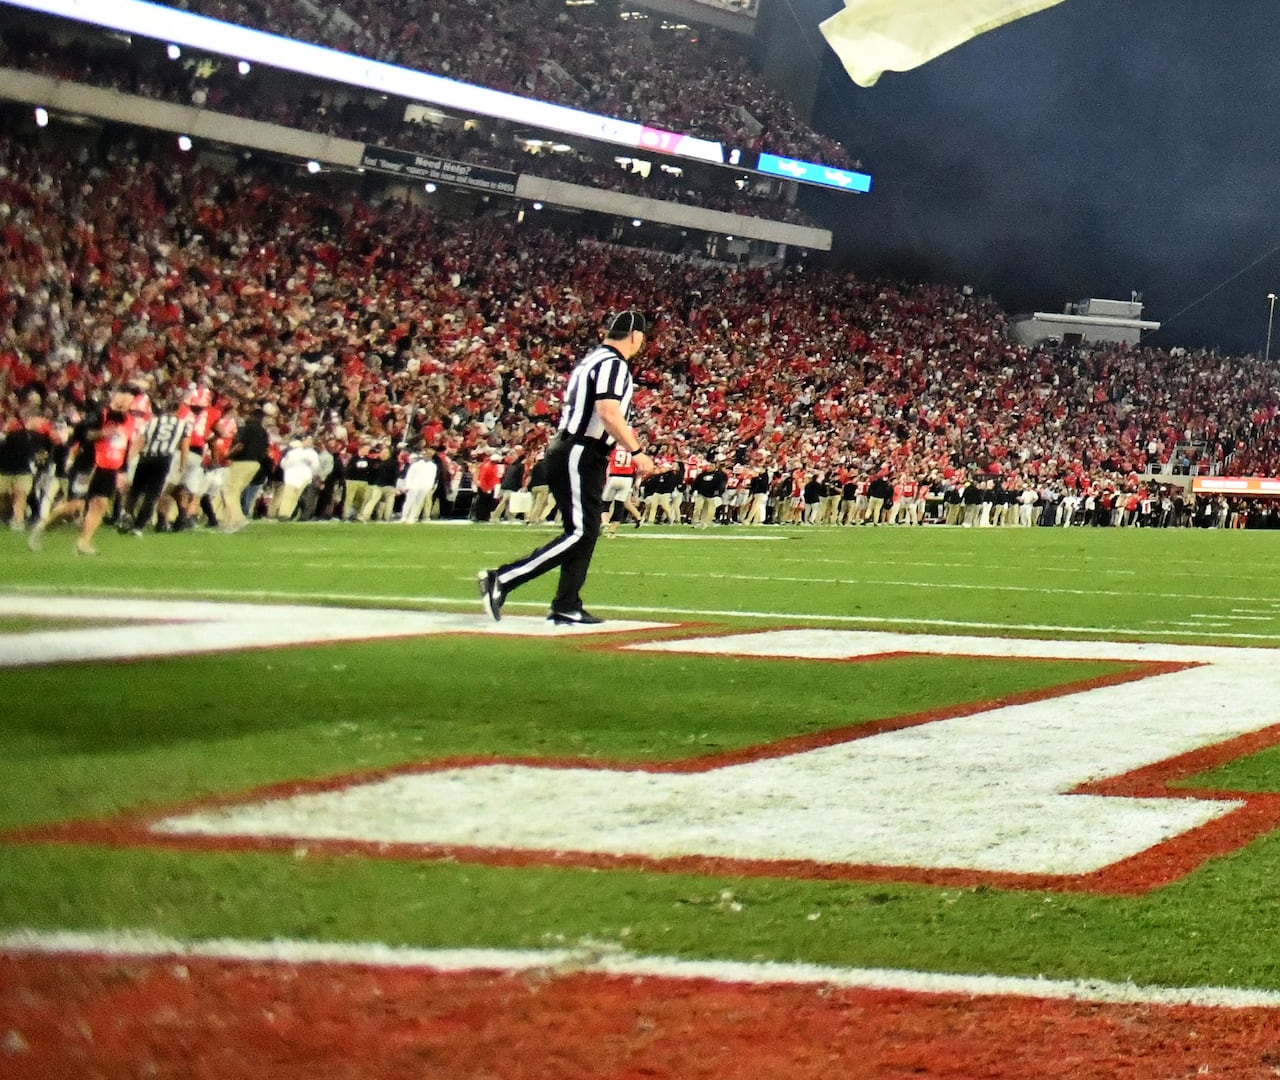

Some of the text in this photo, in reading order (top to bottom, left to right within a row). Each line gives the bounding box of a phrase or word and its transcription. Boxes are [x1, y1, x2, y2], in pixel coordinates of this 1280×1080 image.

[415, 156, 471, 175] Need Help?
[615, 451, 631, 467] 91
